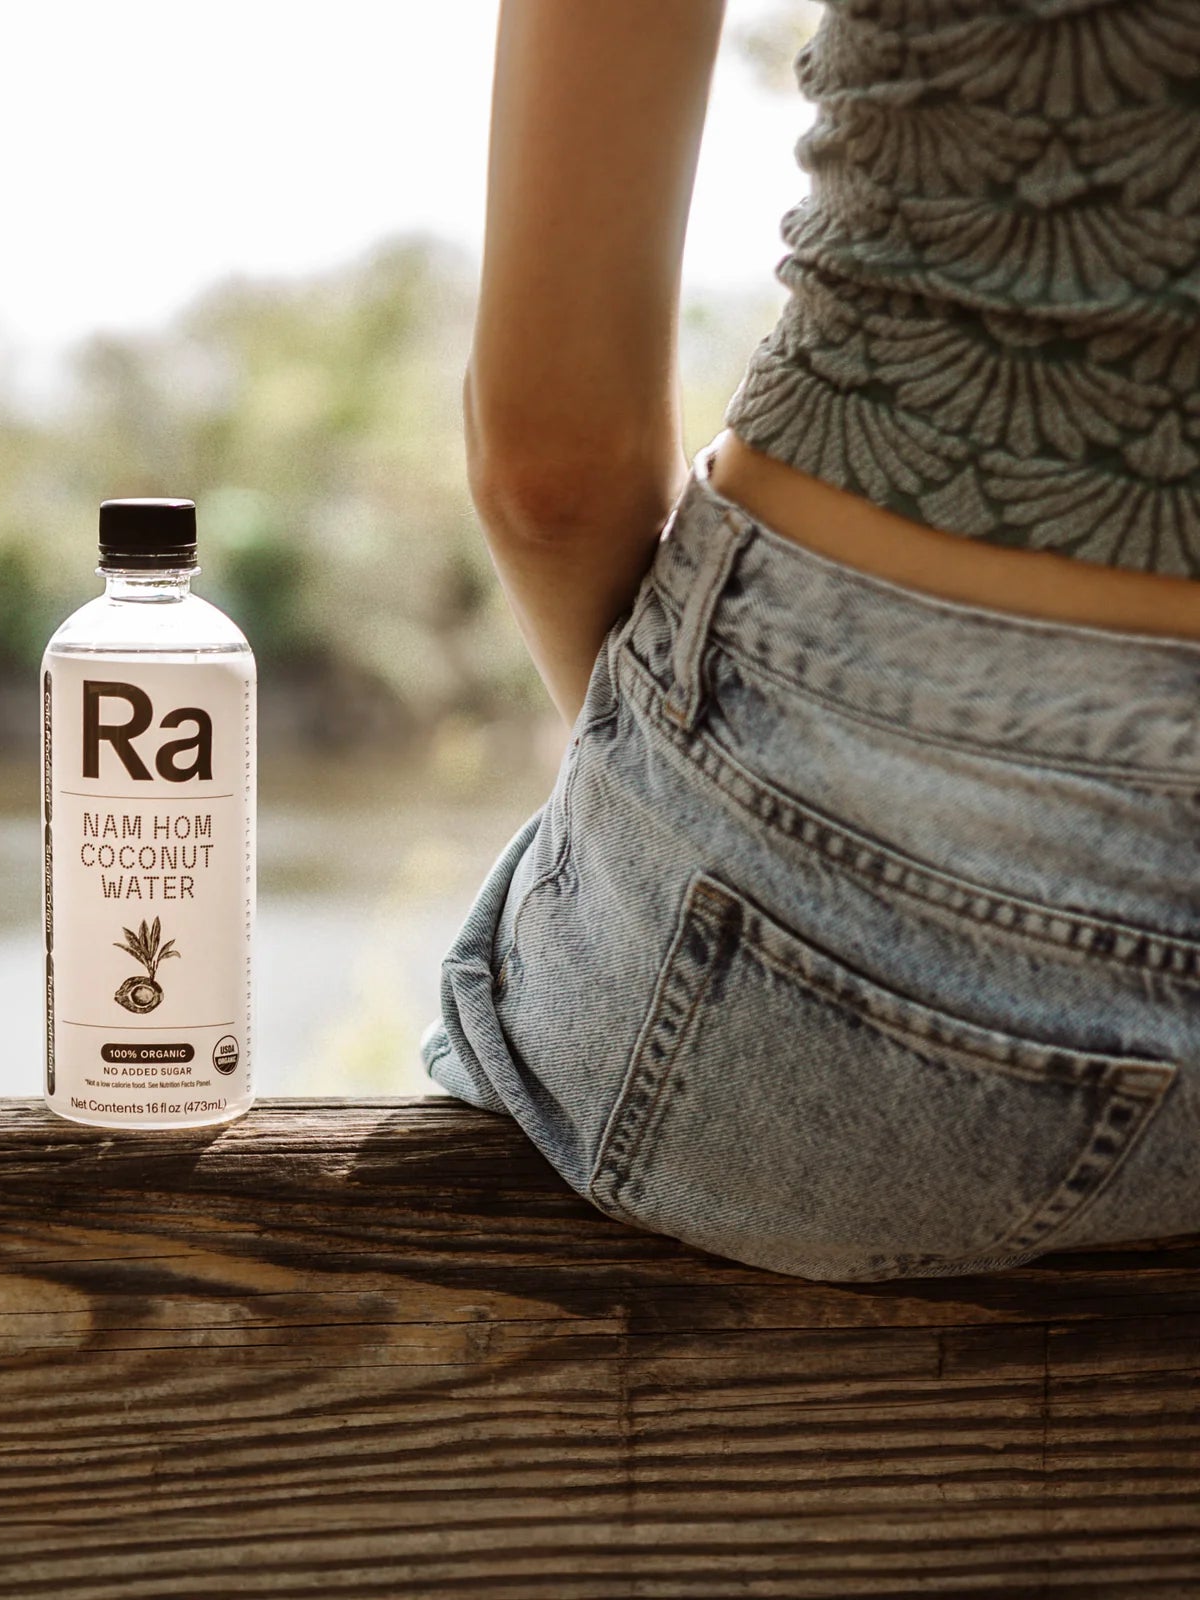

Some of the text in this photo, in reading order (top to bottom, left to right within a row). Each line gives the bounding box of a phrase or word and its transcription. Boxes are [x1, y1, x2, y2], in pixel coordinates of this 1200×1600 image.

[83, 680, 213, 783] Ra
[84, 813, 212, 839] NAM HOM
[81, 843, 214, 869] COCONUT
[101, 874, 194, 899] WATER
[110, 1049, 186, 1059] 100% ORGANIC
[220, 1045, 235, 1054] USDA
[217, 1055, 237, 1065] ORGANIC
[103, 1067, 192, 1076] NO ADDED SUGAR
[70, 1097, 227, 1114] Net Contents 16 fl oz (473mL)
